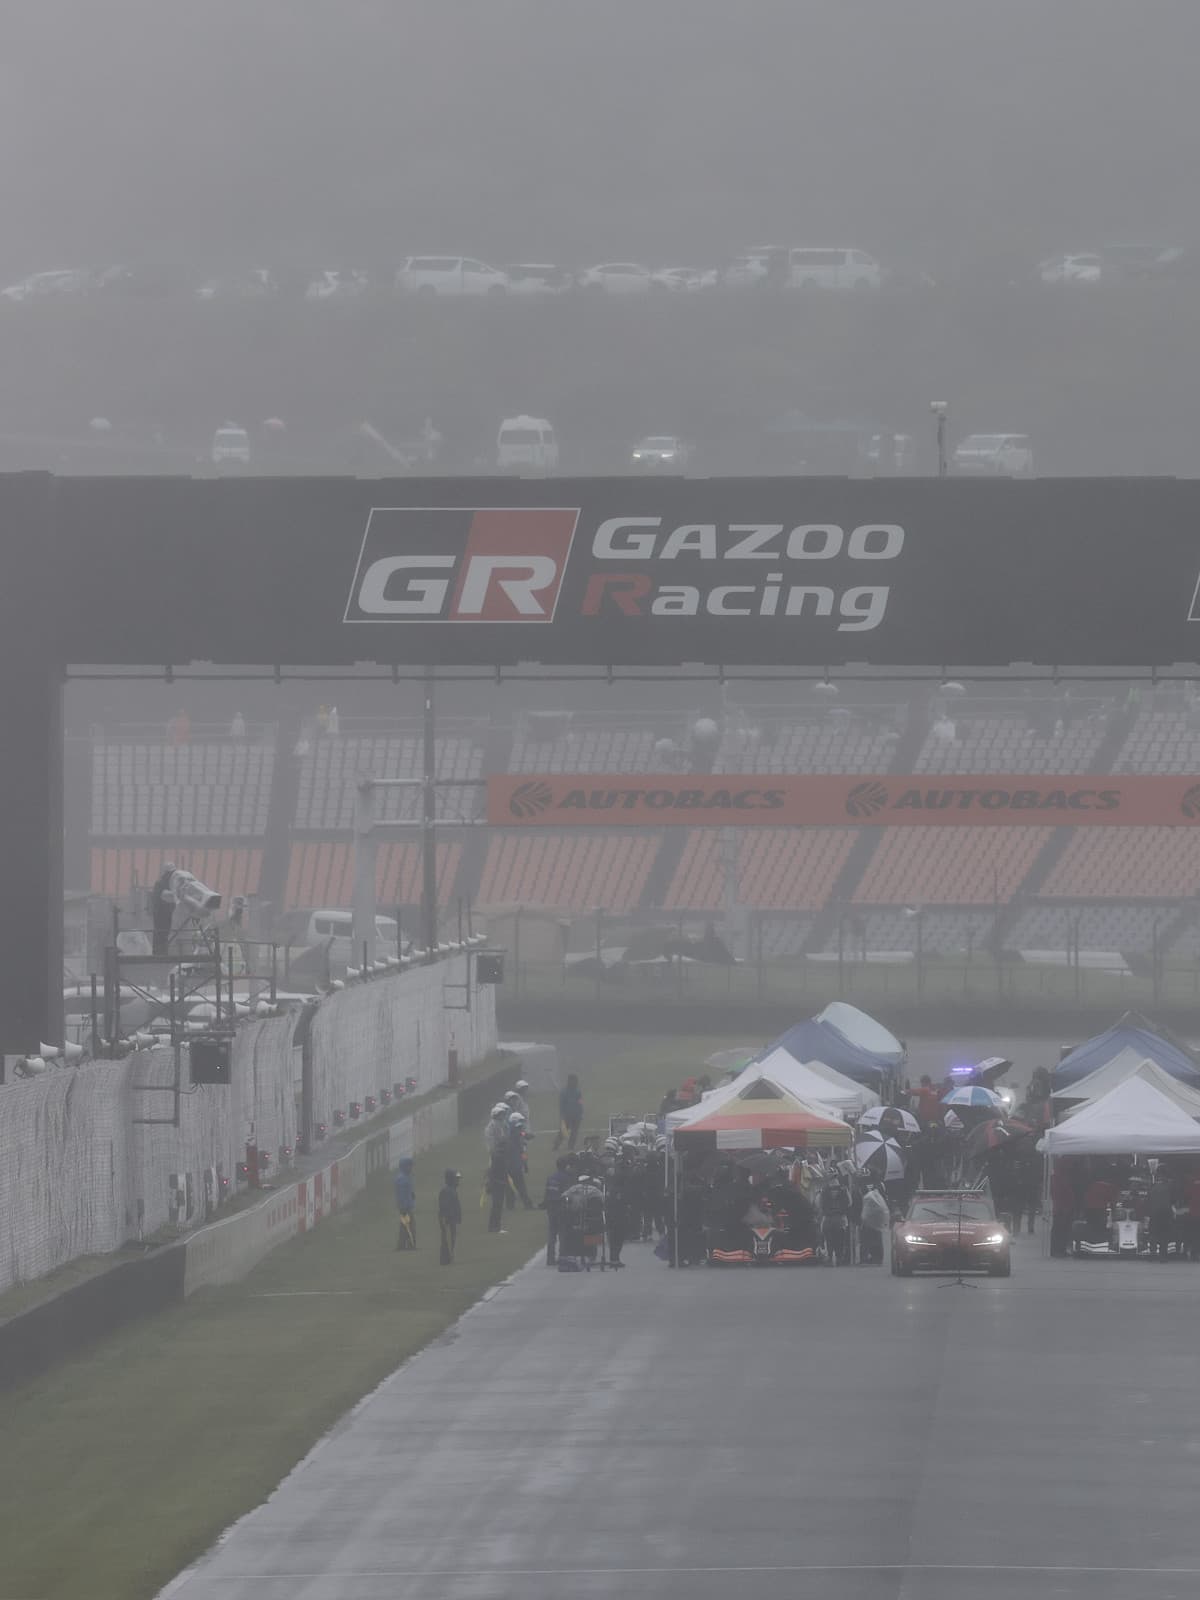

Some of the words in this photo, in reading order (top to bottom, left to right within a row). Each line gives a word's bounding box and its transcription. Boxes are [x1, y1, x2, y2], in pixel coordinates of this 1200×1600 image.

[592, 516, 906, 560] GAZOO
[357, 555, 557, 615] GR
[580, 572, 891, 632] Racing
[555, 788, 786, 810] AUTOBACS
[891, 789, 1121, 811] AUTOBACS
